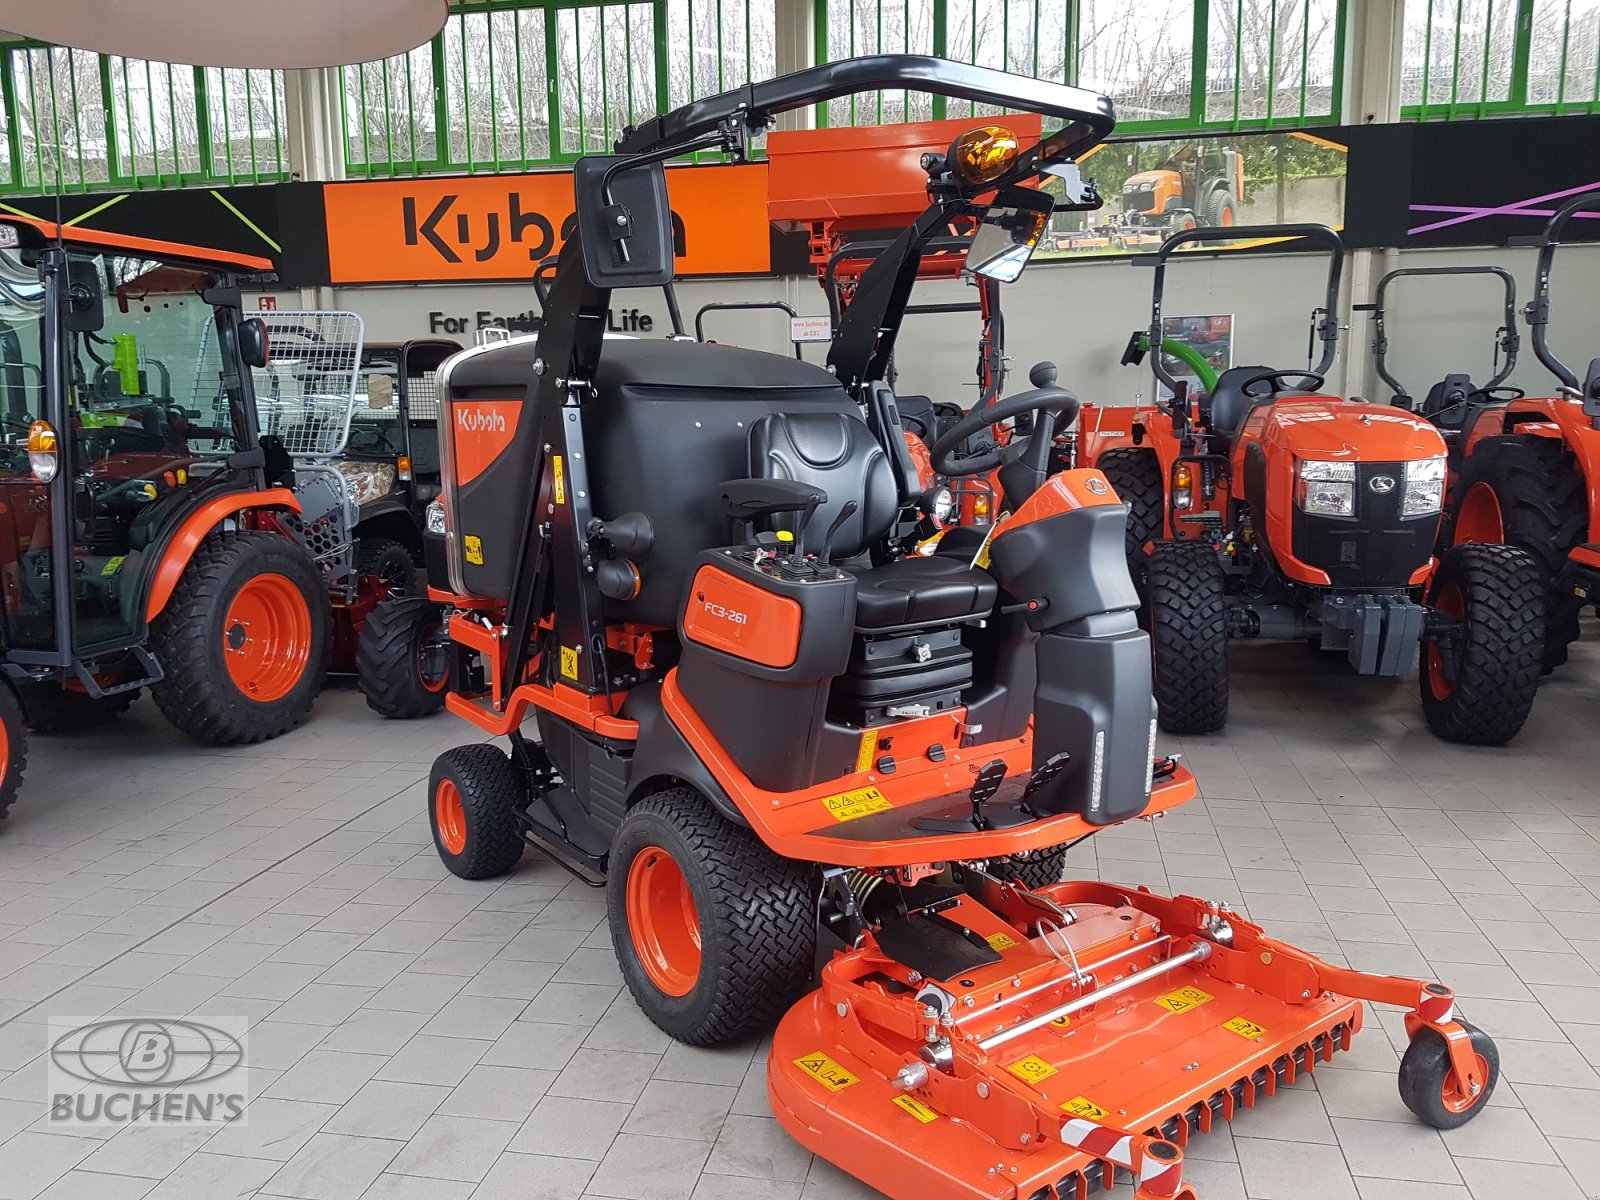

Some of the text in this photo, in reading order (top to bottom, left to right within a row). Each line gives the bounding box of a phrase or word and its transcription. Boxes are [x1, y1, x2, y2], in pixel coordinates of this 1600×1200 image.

[430, 311, 469, 334] For
[608, 309, 653, 332] Life
[457, 408, 505, 432] Kubota
[704, 601, 747, 625] FC3-261
